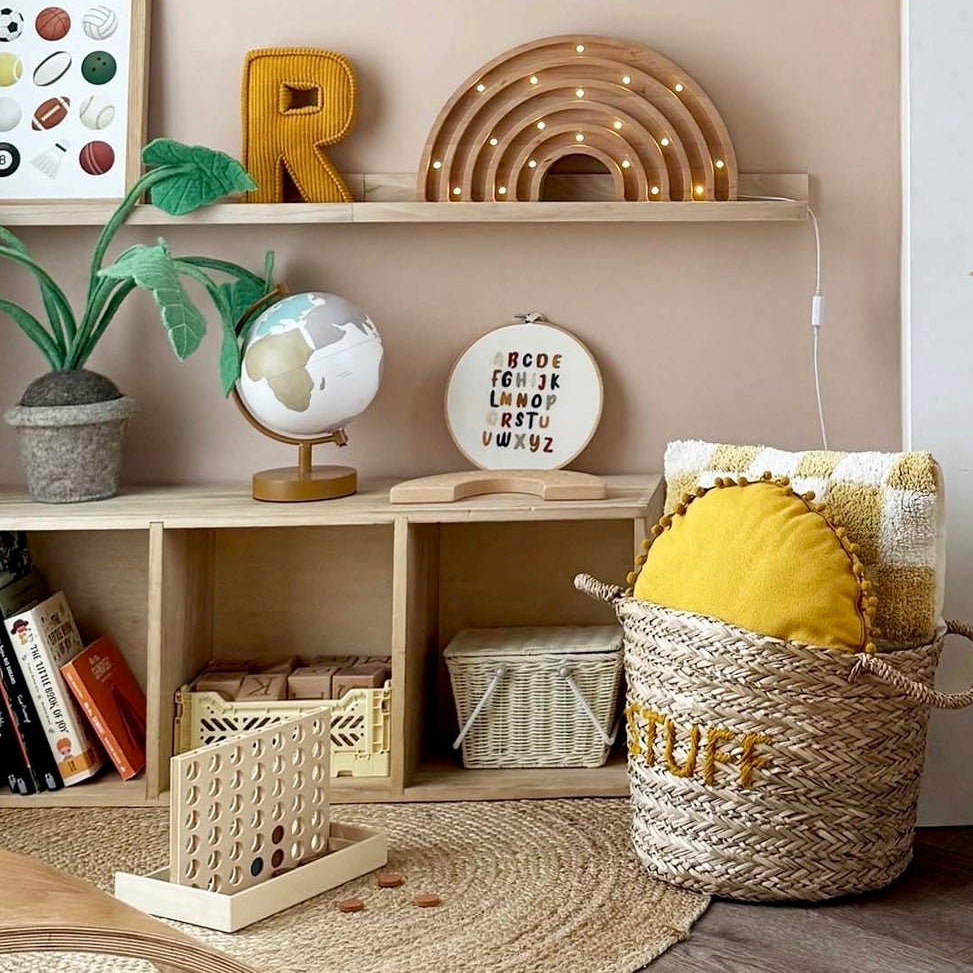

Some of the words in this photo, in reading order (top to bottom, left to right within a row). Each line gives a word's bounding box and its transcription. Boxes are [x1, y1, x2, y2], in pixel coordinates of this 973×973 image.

[242, 47, 358, 203] R
[30, 643, 41, 660] THE
[45, 687, 59, 710] BOOK
[53, 708, 63, 719] OF
[55, 718, 69, 733] JOY
